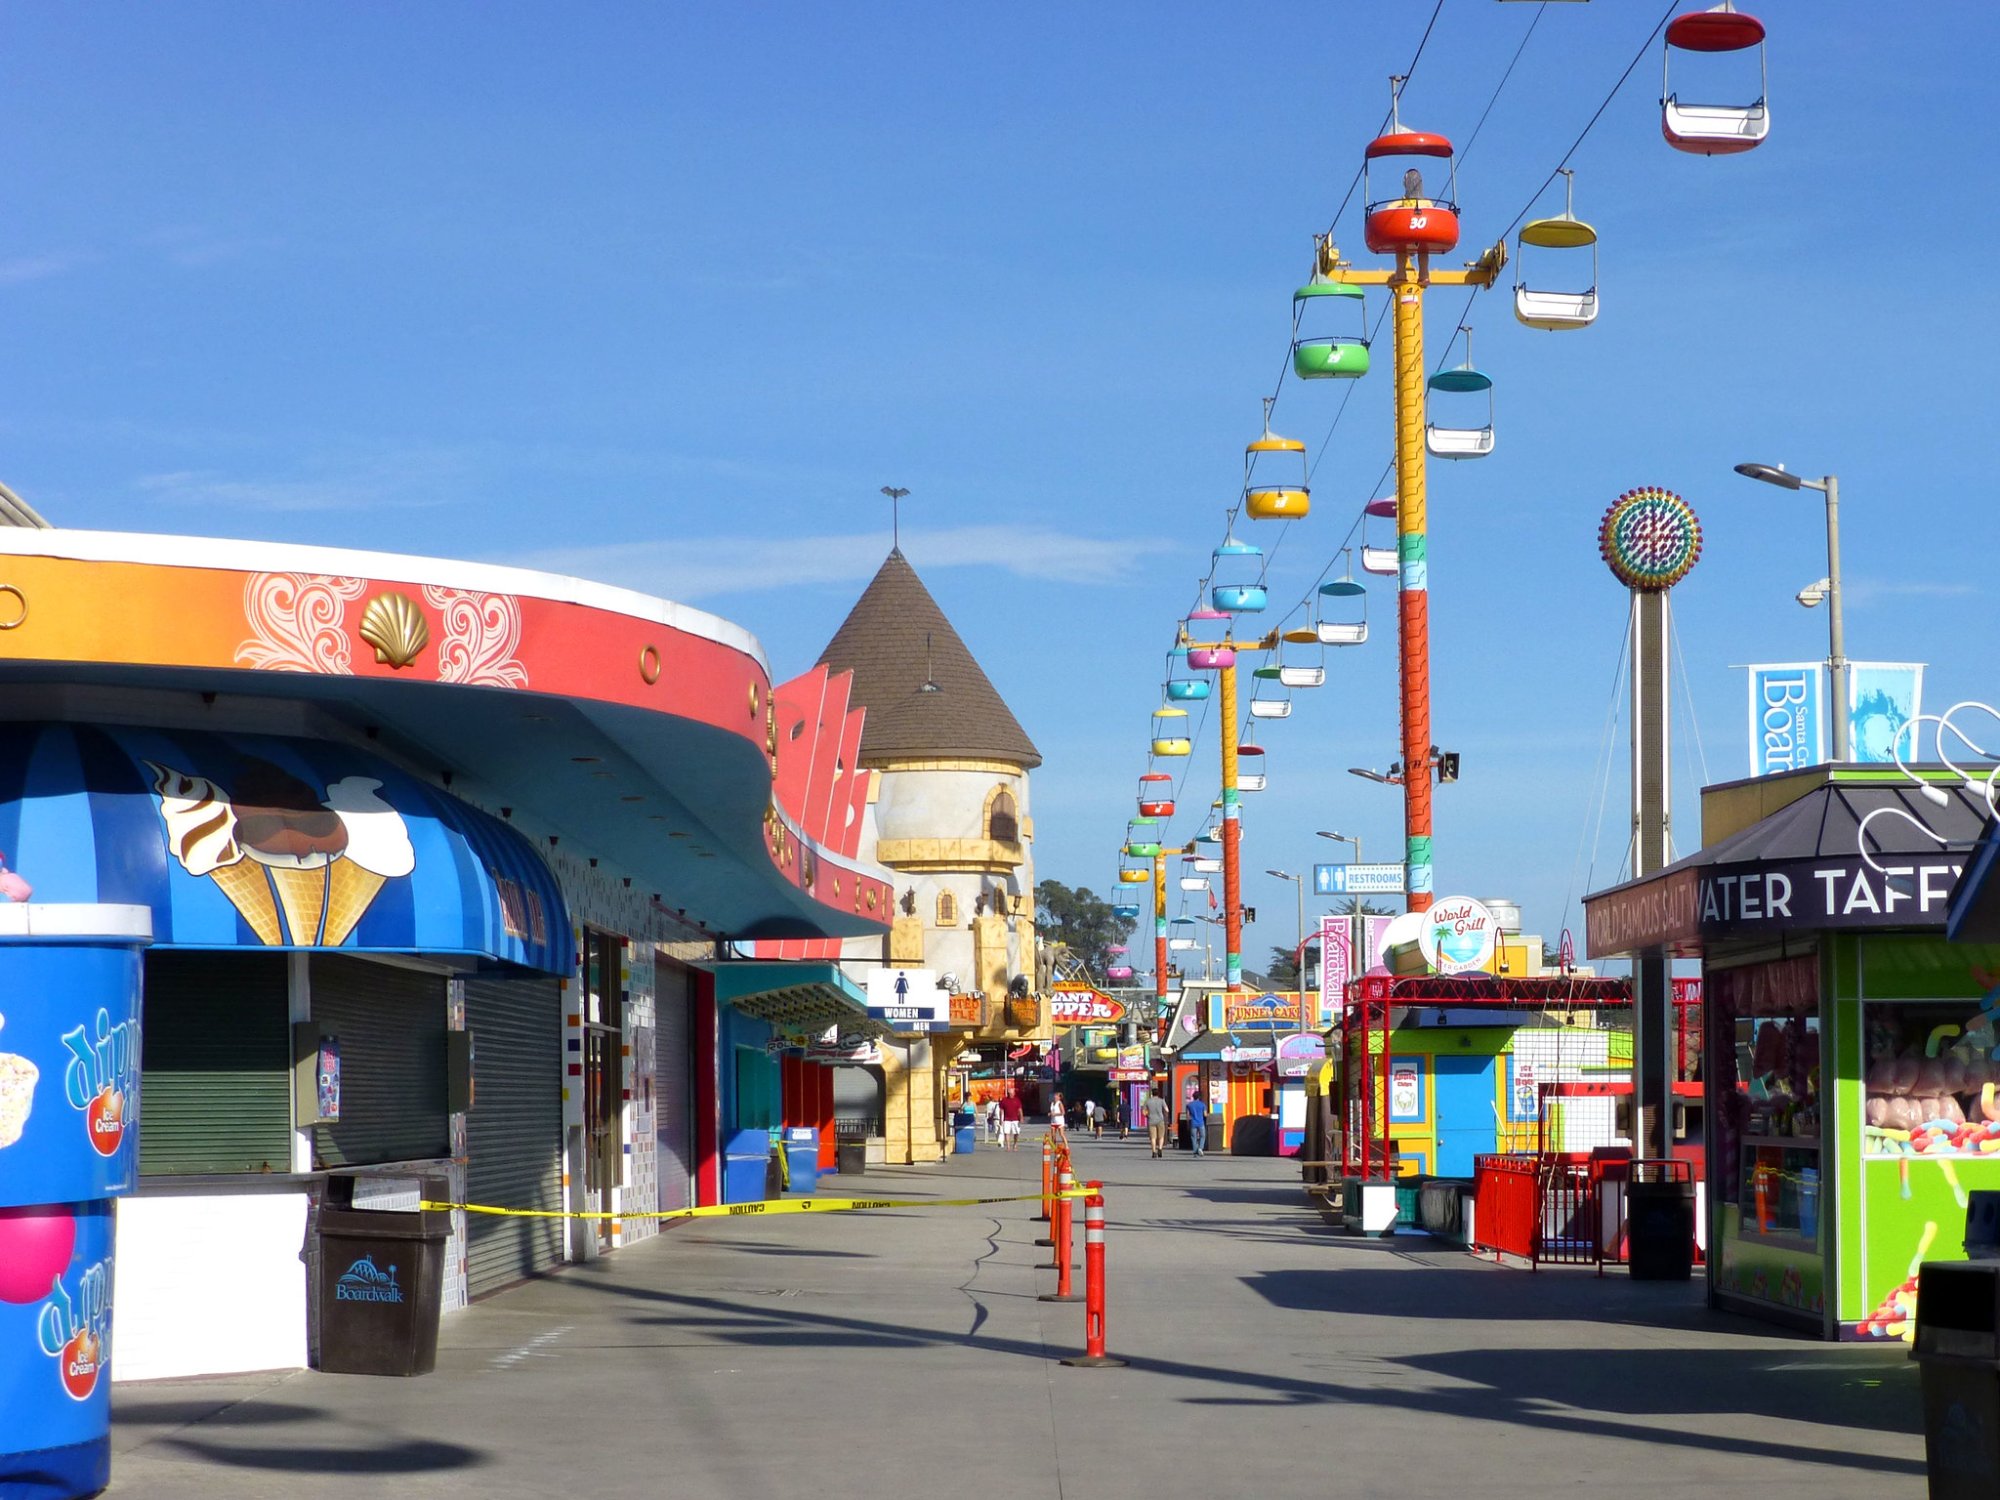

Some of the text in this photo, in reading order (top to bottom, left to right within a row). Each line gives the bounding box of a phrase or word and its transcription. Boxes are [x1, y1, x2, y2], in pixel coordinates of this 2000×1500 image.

[1409, 217, 1427, 229] 30
[1764, 671, 1807, 775] Boar
[1795, 705, 1808, 745] Santa
[1349, 873, 1402, 883] RESTROOMS
[1434, 905, 1472, 924] World
[1588, 905, 1618, 947] WORLD
[1621, 894, 1660, 942] FAMOUS
[1662, 884, 1686, 933] SALT
[1689, 872, 1792, 922] WATER
[1455, 917, 1486, 935] Grill
[1327, 919, 1346, 1009] Boardwalk
[884, 1008, 918, 1018] WOMEN
[1228, 1006, 1271, 1023] FUNNEL
[913, 1022, 930, 1031] MEN
[766, 1041, 797, 1054] ROLL
[808, 1029, 835, 1041] BALL
[103, 1107, 113, 1121] Ice
[95, 1119, 119, 1133] Cream
[730, 1203, 765, 1215] CAUTION
[335, 1284, 404, 1303] Boardwalk
[77, 1351, 89, 1364] Ice
[69, 1361, 95, 1377] Cream
